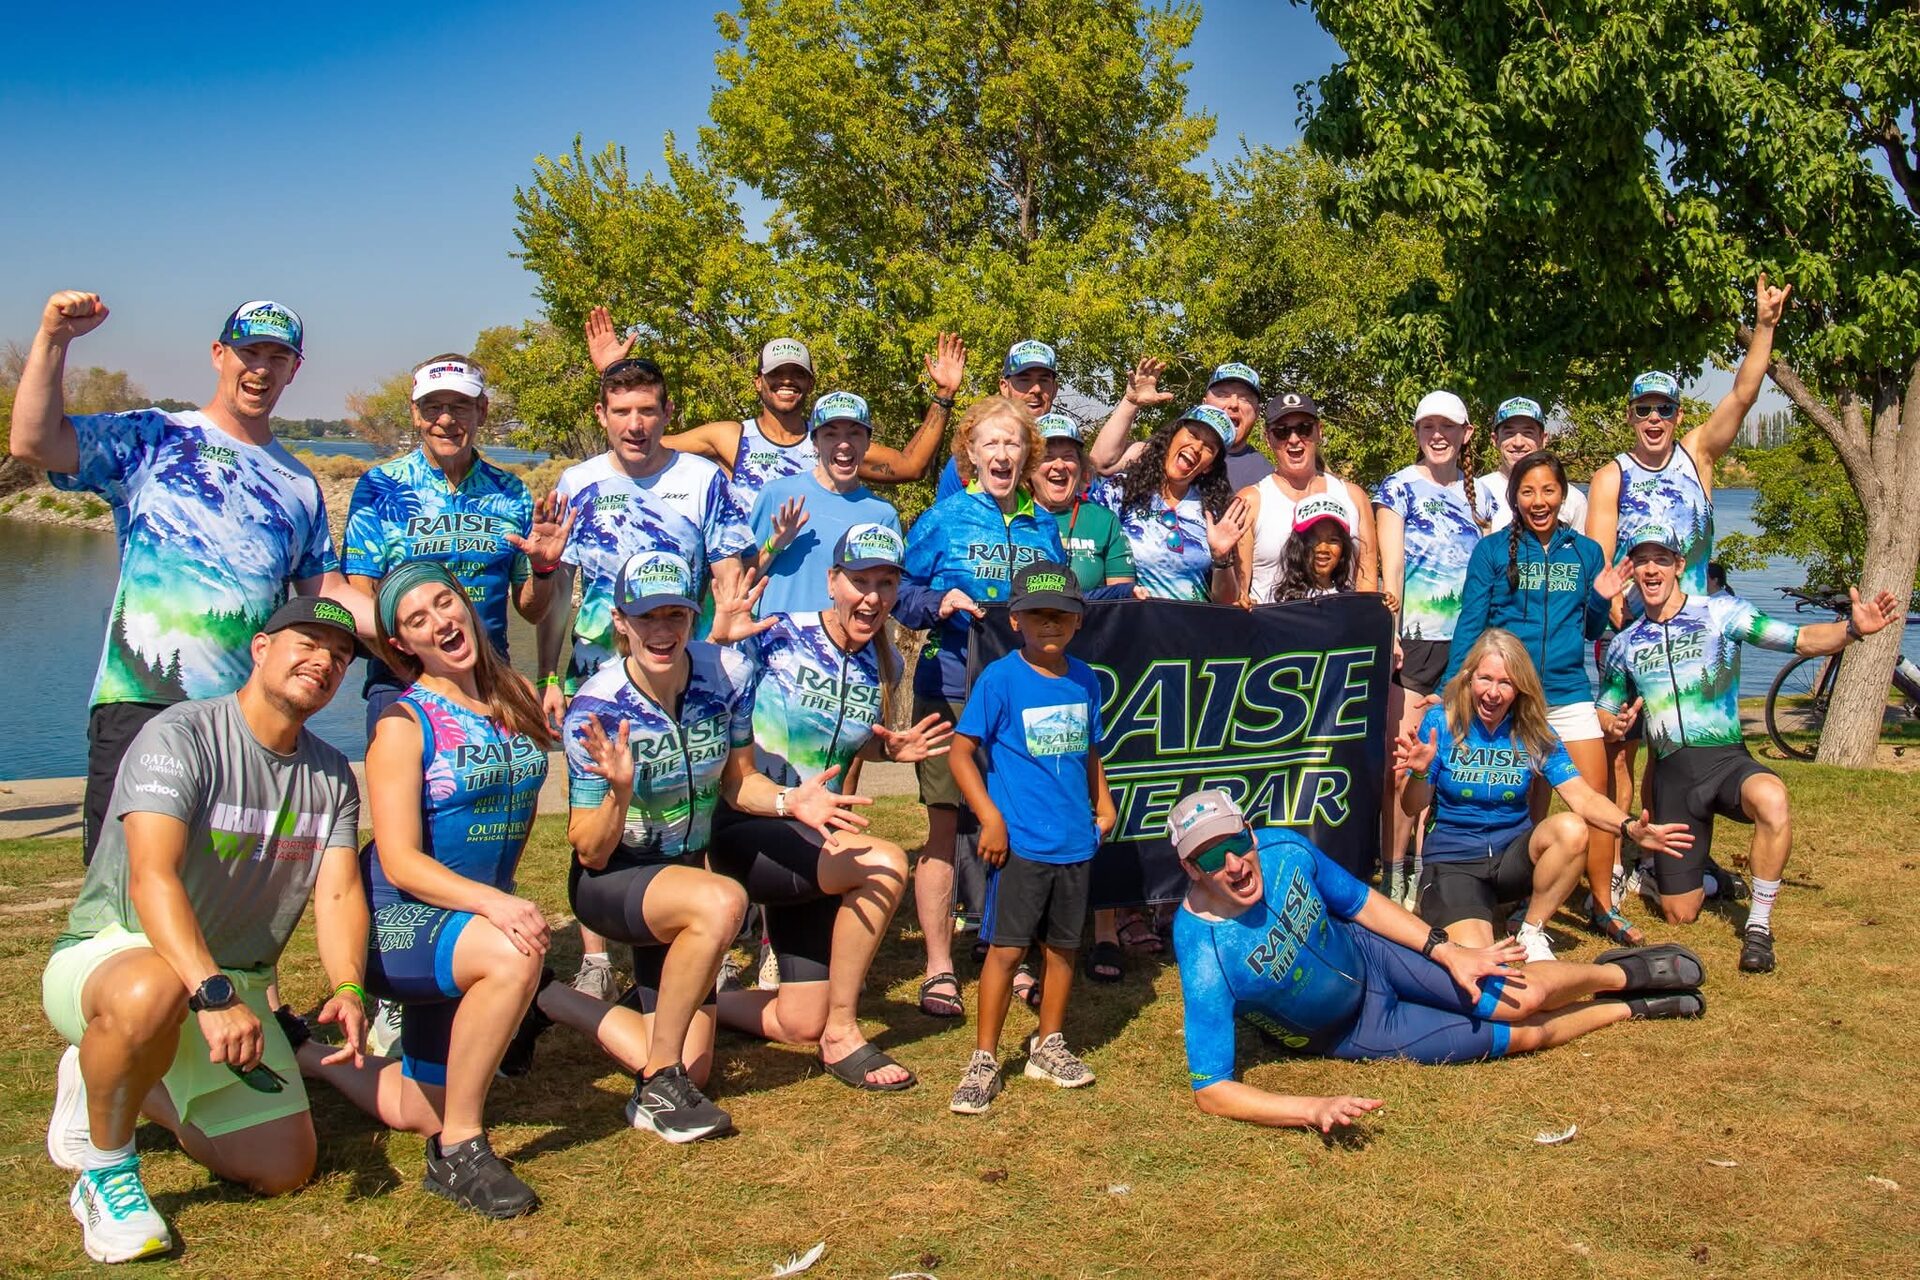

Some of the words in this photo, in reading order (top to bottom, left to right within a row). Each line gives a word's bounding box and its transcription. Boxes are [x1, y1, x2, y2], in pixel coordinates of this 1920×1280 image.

[197, 442, 240, 459] RAISE
[750, 452, 780, 460] RAISE
[594, 493, 631, 505] RAISE
[1297, 500, 1344, 516] RAISE
[405, 512, 502, 538] RAISE
[411, 539, 452, 557] THE
[456, 538, 498, 554] BAR
[858, 532, 897, 545] RAISE
[967, 542, 1047, 565] RAISE
[638, 563, 684, 576] RAISE
[973, 565, 1007, 581] THE
[1026, 573, 1067, 585] RAISE
[1516, 561, 1581, 579] RAISE
[1547, 579, 1577, 593] BAR
[1633, 629, 1712, 665] RAISE
[1637, 656, 1665, 676] THE
[1670, 648, 1704, 665] BAR
[796, 664, 881, 708] RAISE
[800, 693, 838, 713] THE
[843, 705, 877, 725] BAR
[631, 712, 730, 762] RAISE
[455, 732, 540, 770] RAIS
[1449, 746, 1530, 768] RAISE
[640, 756, 682, 781] THE
[689, 743, 727, 764] BAR
[464, 767, 505, 792] THE
[1451, 770, 1484, 784] THE
[1487, 771, 1523, 786] BAR
[135, 780, 179, 798] wahoo
[473, 806, 500, 815] REAL
[466, 834, 505, 842] PHYSICAL
[375, 902, 441, 926] AISE
[1245, 866, 1311, 977] RAISE
[379, 931, 416, 953] BAR
[1268, 940, 1299, 984] THE
[1295, 896, 1322, 948] BAR
